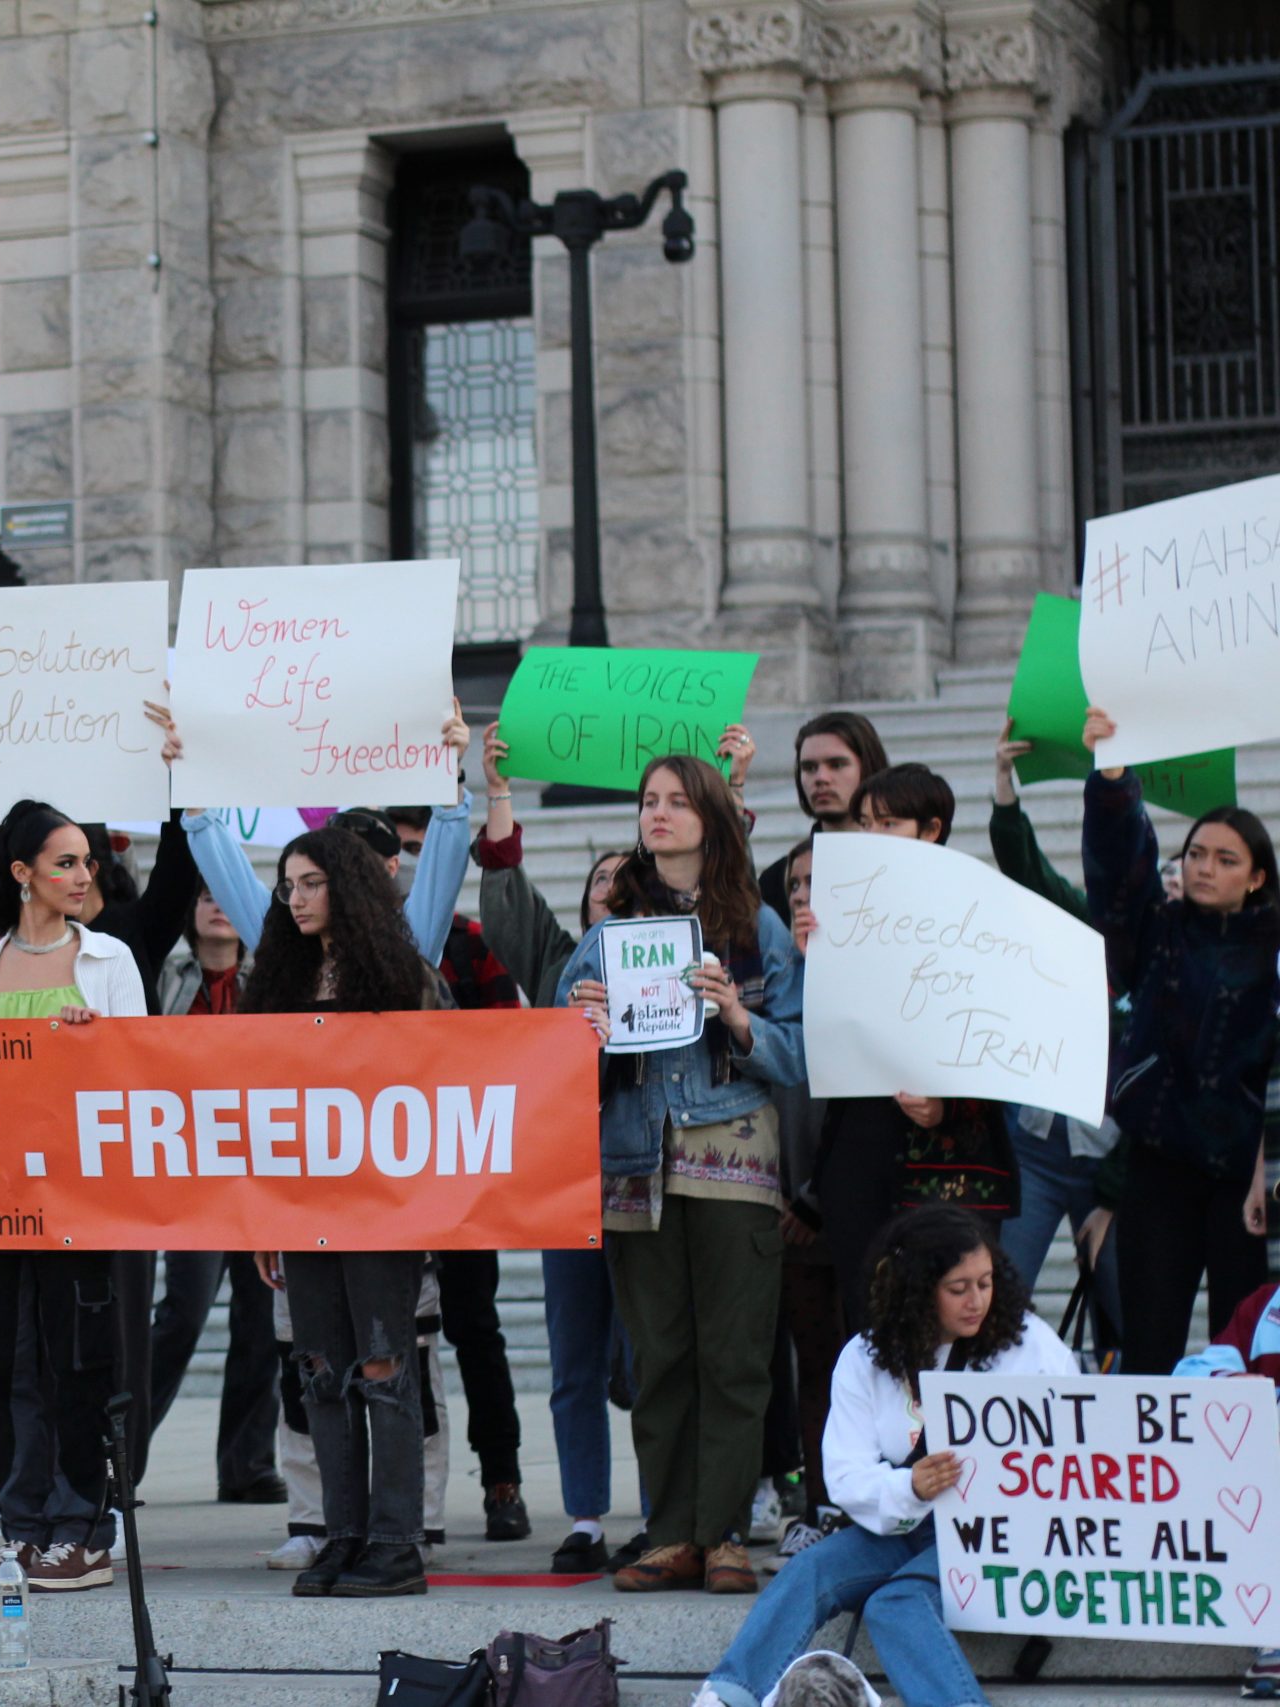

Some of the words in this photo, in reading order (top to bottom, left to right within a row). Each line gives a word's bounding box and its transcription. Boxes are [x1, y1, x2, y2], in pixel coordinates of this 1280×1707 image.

[205, 597, 350, 652] Women
[1145, 582, 1280, 674] AMIN
[245, 652, 332, 726] Life
[534, 660, 586, 692] THE
[607, 661, 724, 708] VOICES
[295, 718, 453, 776] Freedom
[546, 712, 600, 762] OF
[827, 864, 1068, 989] Freedom
[641, 986, 660, 998] NOT
[900, 951, 975, 1023] for
[936, 1007, 1065, 1078] IRAN
[75, 1083, 518, 1179] FREEDOM
[945, 1387, 1096, 1447] DON'T
[1136, 1392, 1195, 1444] BE
[998, 1451, 1181, 1503] SCARED
[953, 1516, 1010, 1554] WE
[1044, 1517, 1122, 1557] ARE
[1151, 1520, 1228, 1563] ALL
[982, 1564, 1227, 1628] TOGETHER
